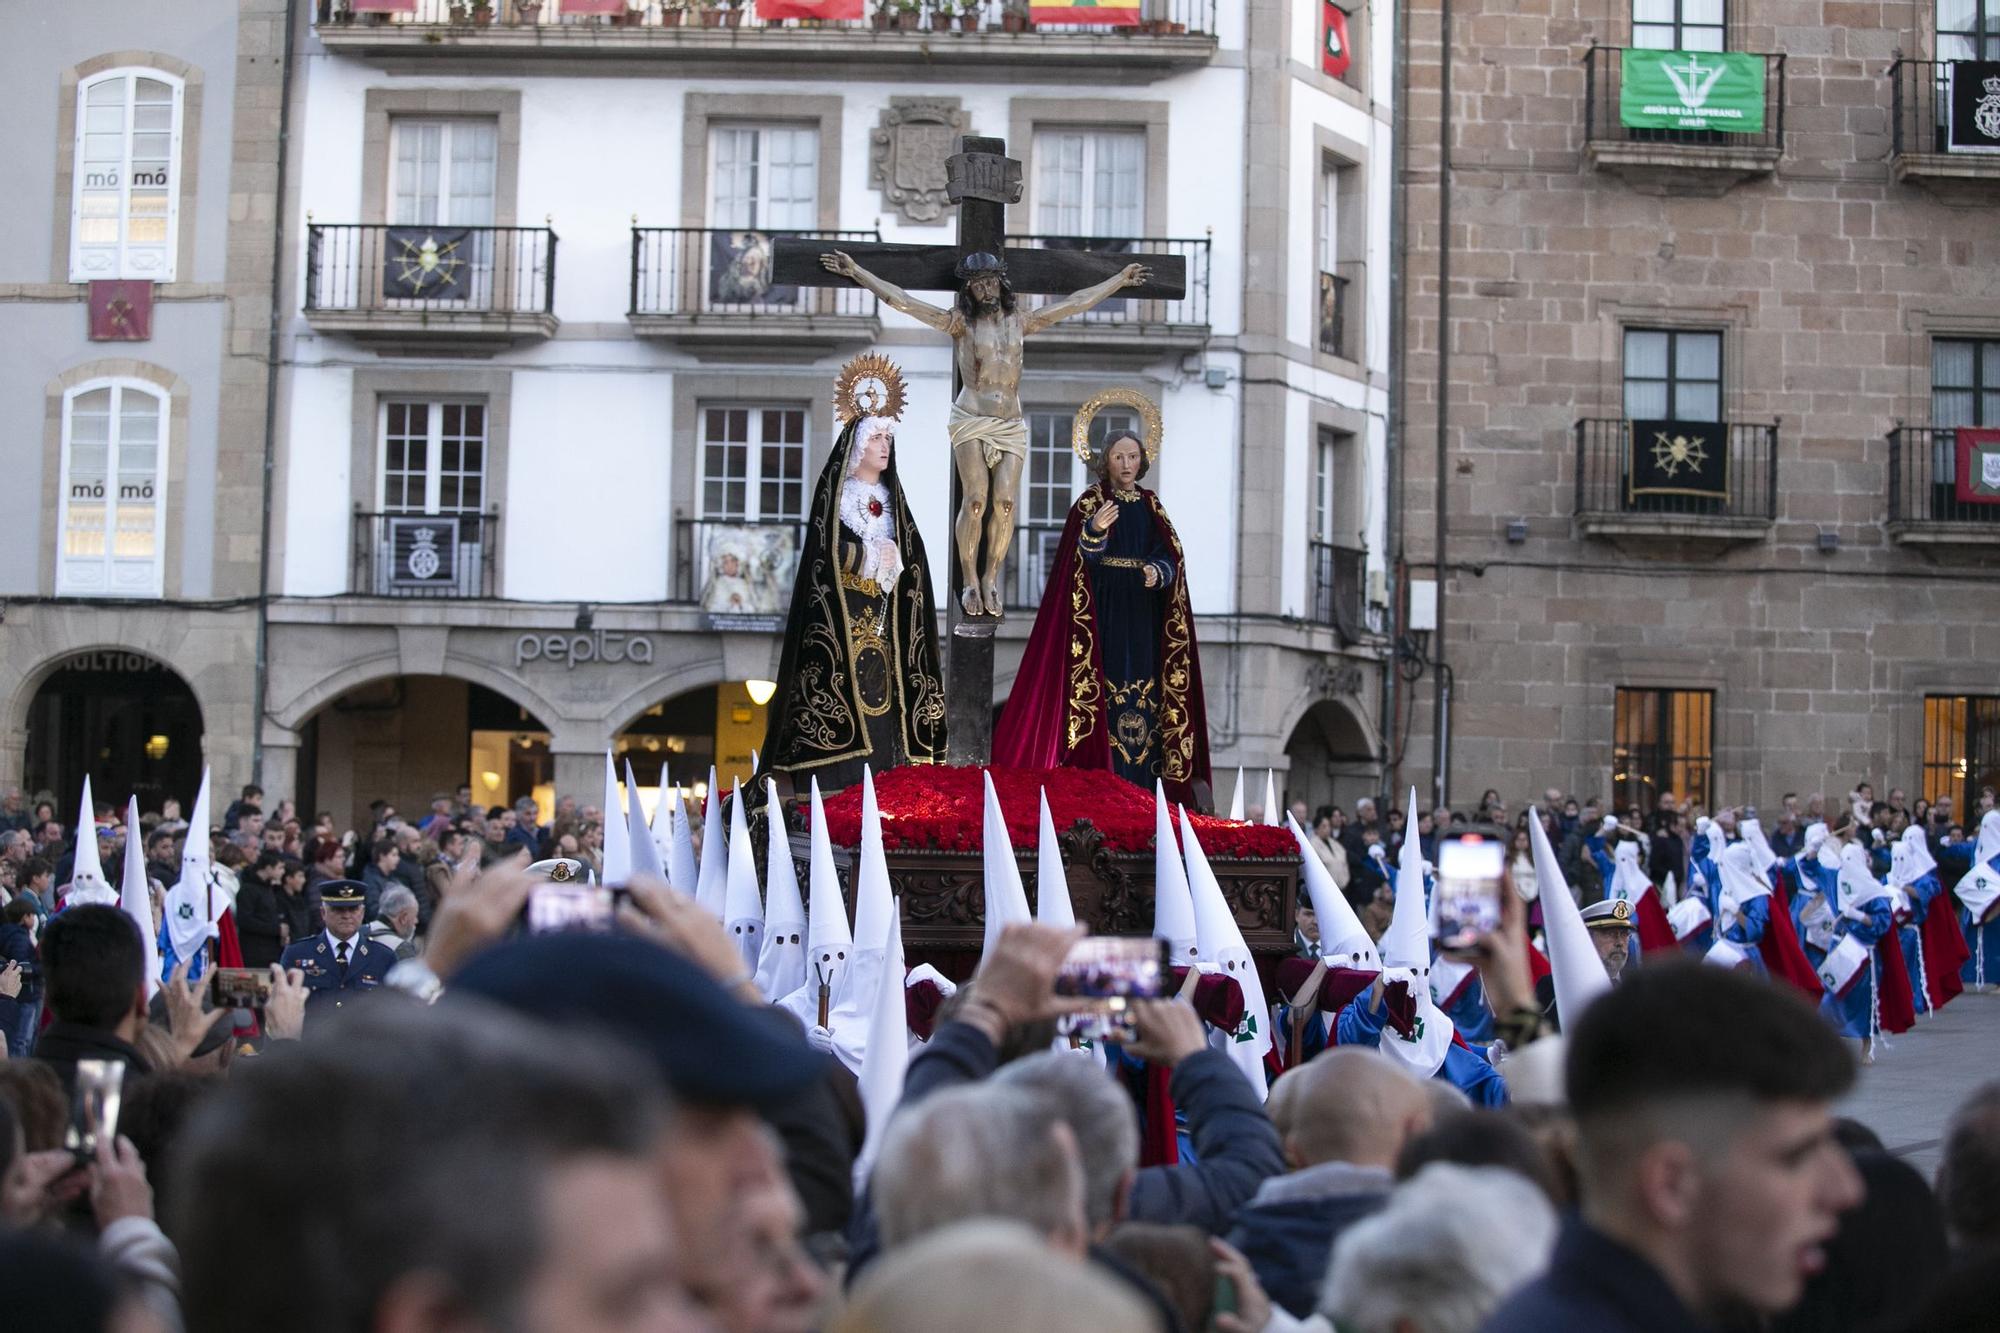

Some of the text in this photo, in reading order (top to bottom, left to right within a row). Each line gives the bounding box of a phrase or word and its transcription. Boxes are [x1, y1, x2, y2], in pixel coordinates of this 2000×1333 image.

[1669, 105, 1681, 115] DE
[1682, 106, 1693, 116] LA
[1694, 107, 1743, 118] ESPERANZA
[86, 168, 118, 186] mó
[133, 167, 167, 185] mó
[72, 480, 104, 498] mó
[120, 480, 153, 498] mó
[515, 629, 653, 669] pepita
